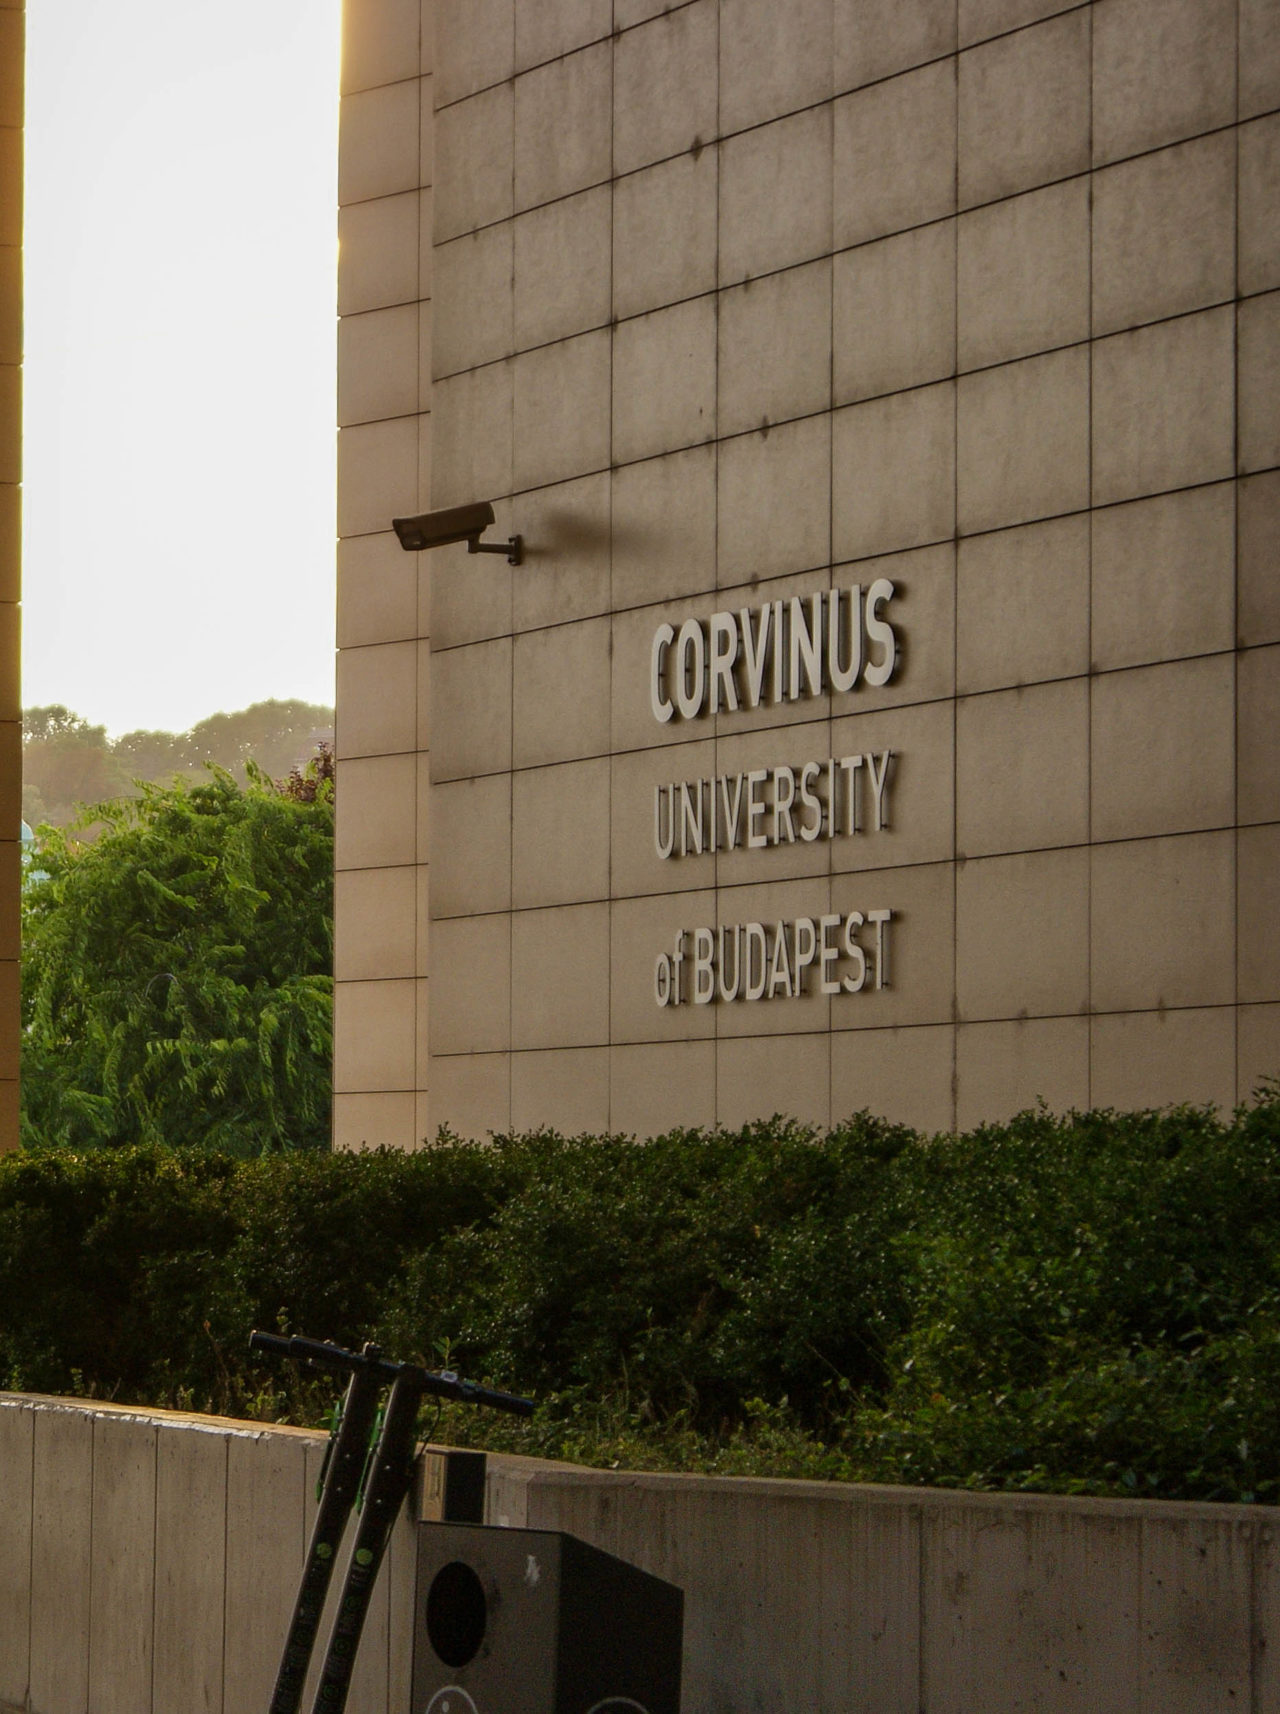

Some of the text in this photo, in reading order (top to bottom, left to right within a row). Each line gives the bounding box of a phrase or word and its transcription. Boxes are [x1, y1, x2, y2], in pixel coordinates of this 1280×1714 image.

[651, 578, 895, 723] CORVINUS
[654, 750, 891, 860] UNIVERSITY
[655, 908, 892, 1007] of BUDAPEST
